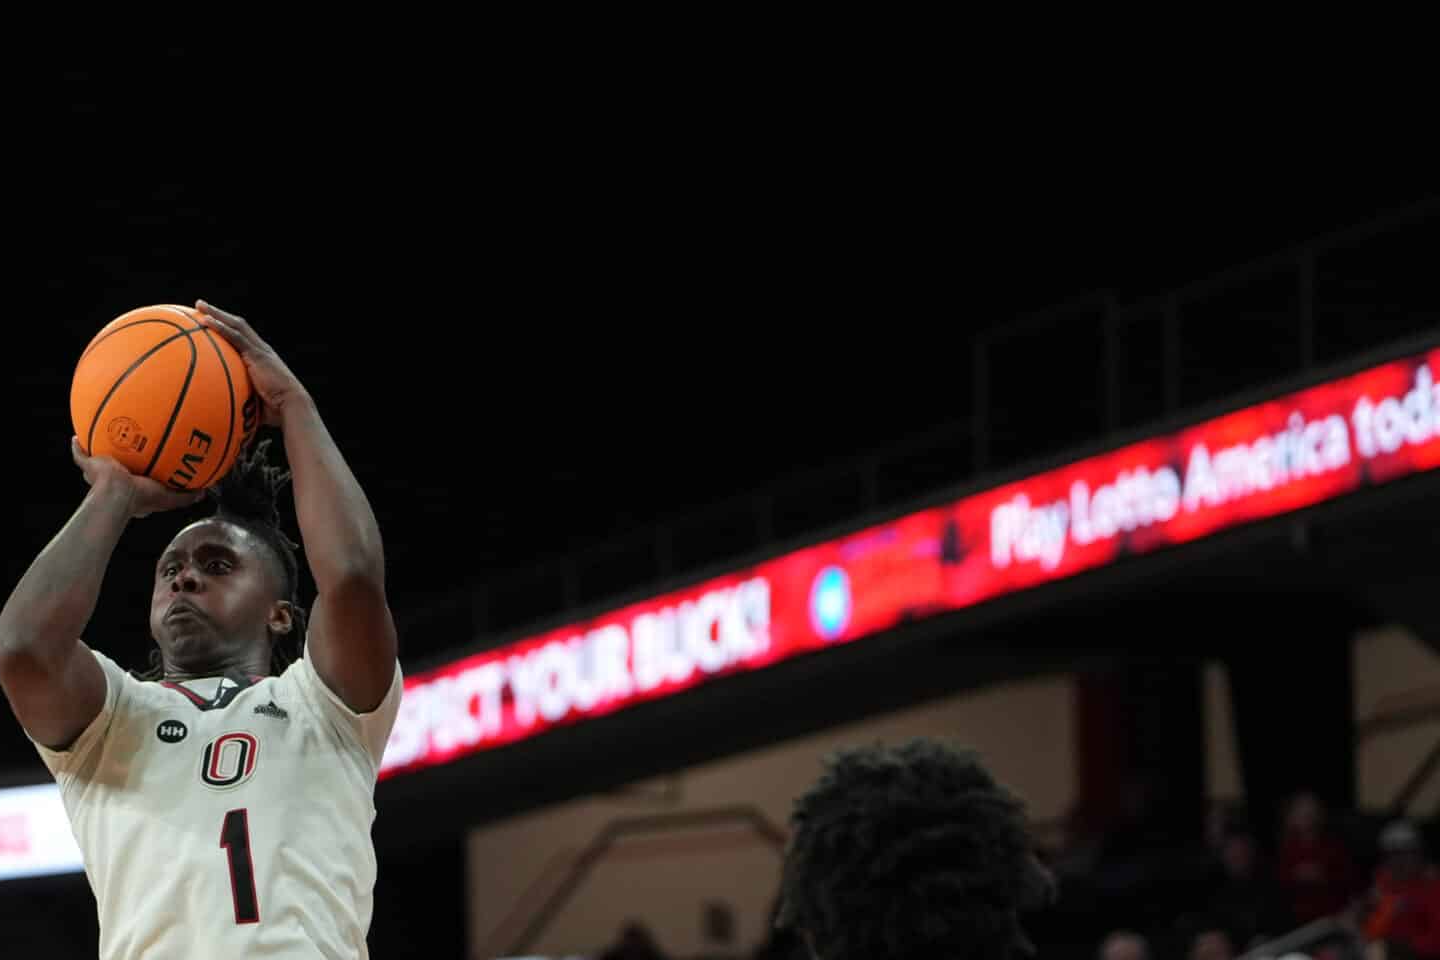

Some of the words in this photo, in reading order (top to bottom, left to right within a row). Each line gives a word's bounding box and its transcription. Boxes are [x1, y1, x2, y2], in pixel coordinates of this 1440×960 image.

[990, 492, 1069, 573] Play
[1070, 479, 1182, 546] Lotto
[1181, 410, 1351, 513] America
[505, 623, 632, 727] YOUR
[219, 808, 260, 925] 1
